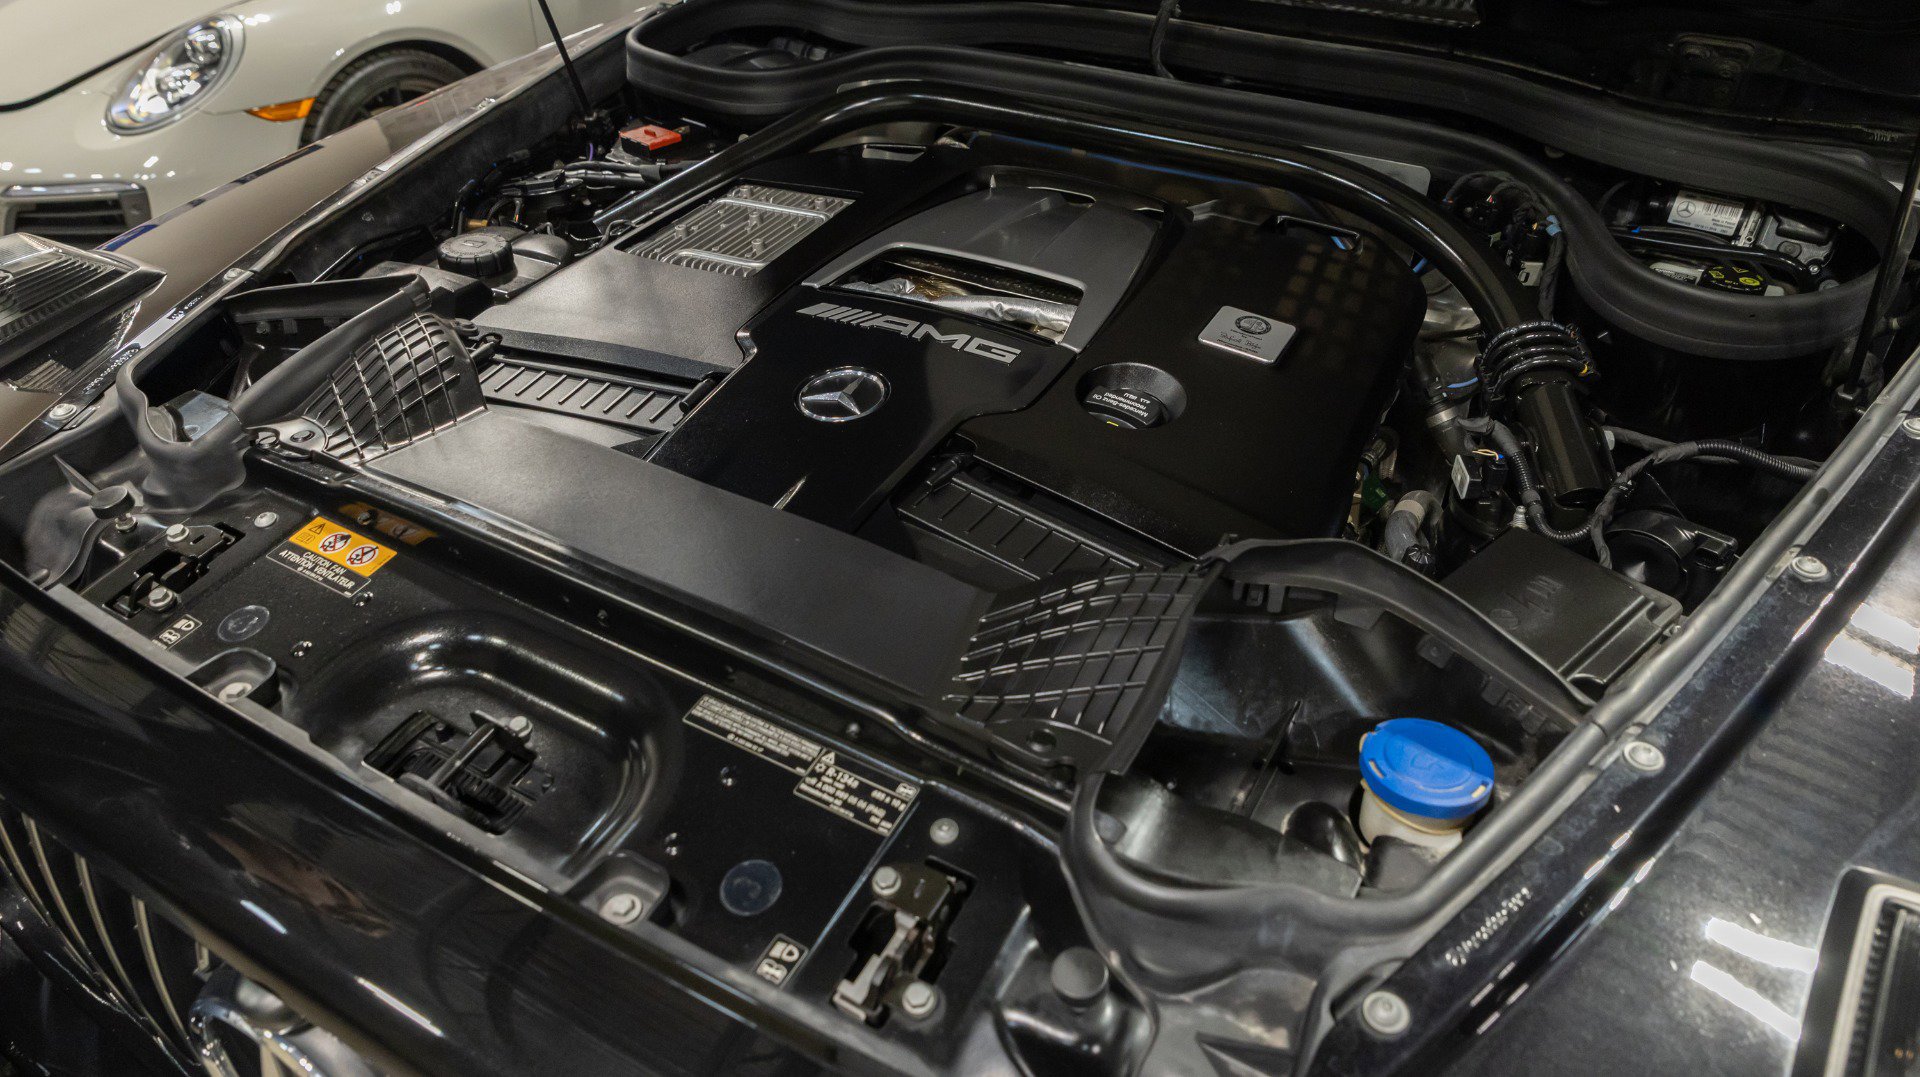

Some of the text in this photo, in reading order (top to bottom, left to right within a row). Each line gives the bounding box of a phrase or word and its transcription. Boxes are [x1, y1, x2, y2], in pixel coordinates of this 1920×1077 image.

[860, 315, 1021, 364] AMG
[1102, 396, 1148, 417] Mercedes-Benz
[1104, 392, 1146, 410] recommended
[279, 550, 314, 569] ATTENTION
[314, 566, 355, 589] VENTILATEUR
[302, 551, 331, 569] CAUTION
[330, 563, 347, 575] FAN
